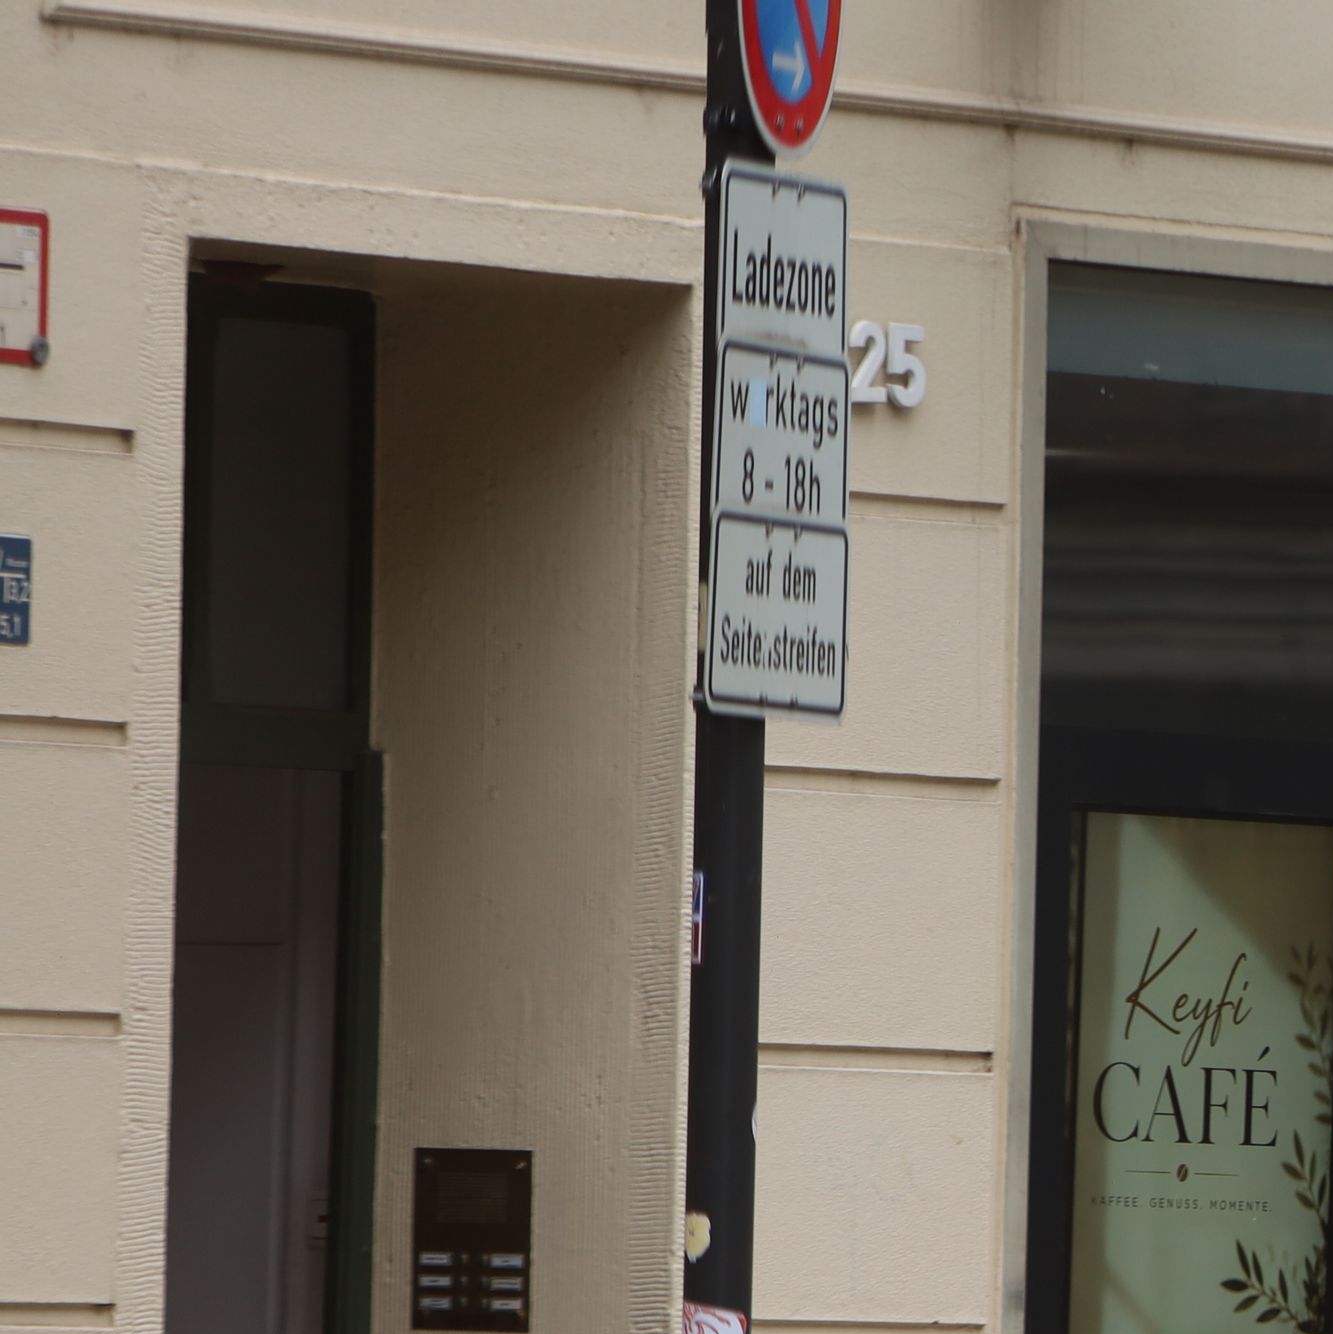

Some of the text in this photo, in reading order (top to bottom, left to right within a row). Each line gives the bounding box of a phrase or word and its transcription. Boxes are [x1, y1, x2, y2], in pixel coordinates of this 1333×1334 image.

[731, 228, 837, 319] Ladezone
[850, 320, 926, 408] 25
[731, 372, 838, 450] wrktags
[742, 449, 755, 504] 8
[784, 454, 821, 516] 18h
[745, 547, 817, 605] auf dem
[1124, 925, 1254, 1068] Keyfi
[1092, 1045, 1279, 1148] CAFÉ
[1208, 1199, 1272, 1213] MOMENTE.
